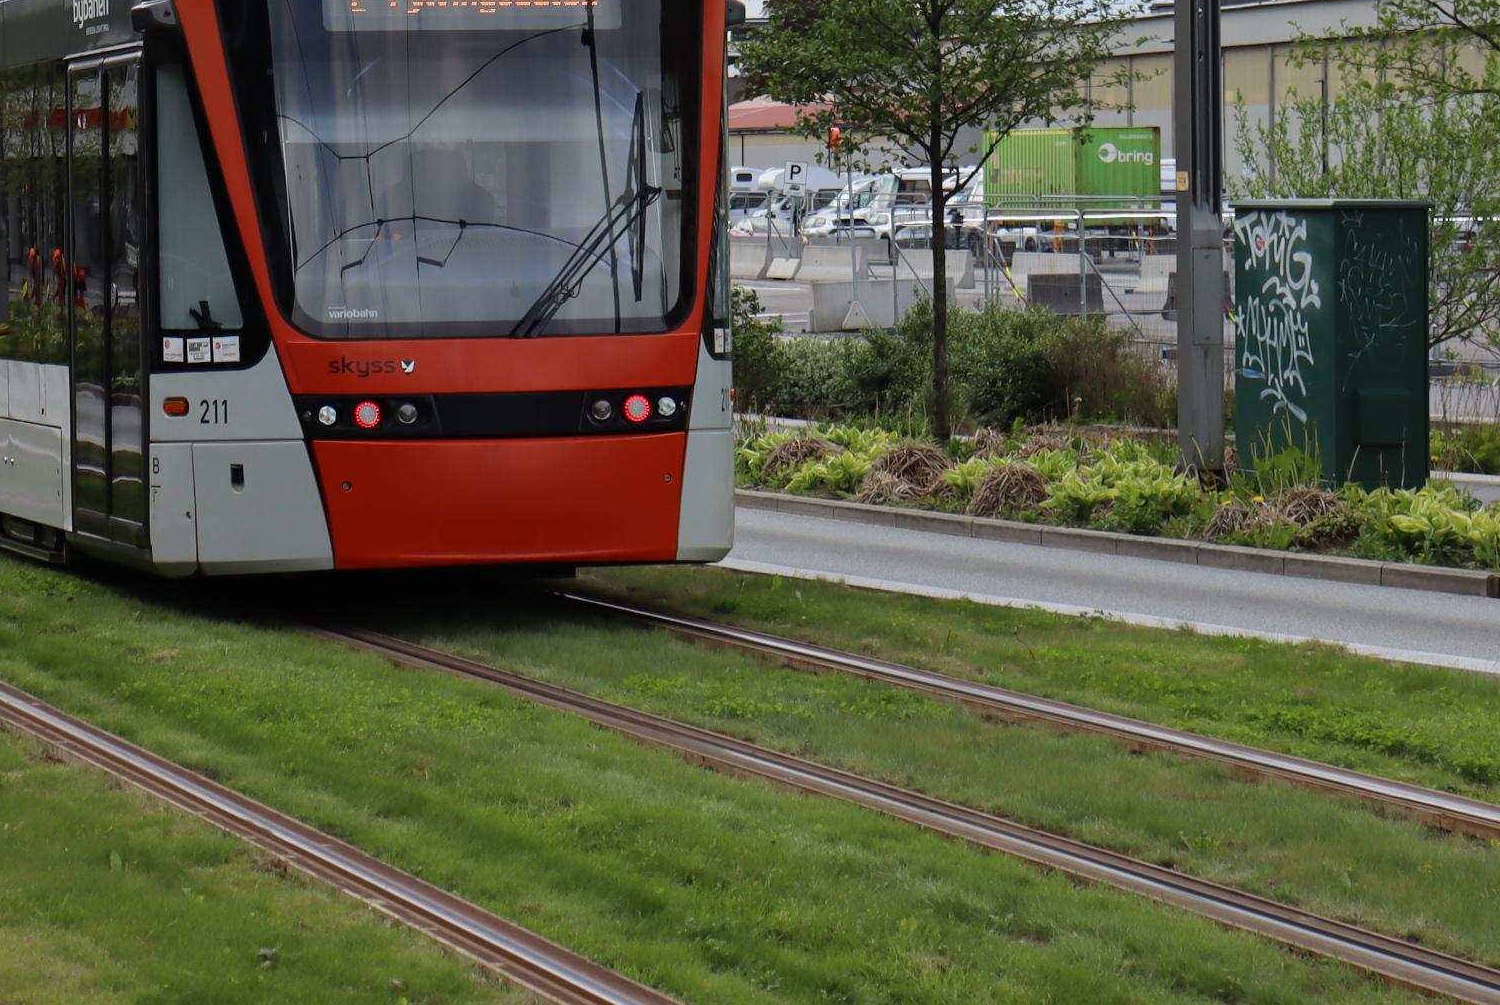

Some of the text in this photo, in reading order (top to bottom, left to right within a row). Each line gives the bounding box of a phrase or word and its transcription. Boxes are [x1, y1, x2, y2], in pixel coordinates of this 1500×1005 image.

[1117, 149, 1154, 165] bring
[790, 164, 802, 180] P
[328, 308, 378, 319] variobahn
[328, 356, 396, 378] skyss
[200, 399, 228, 424] 211
[152, 457, 160, 474] B
